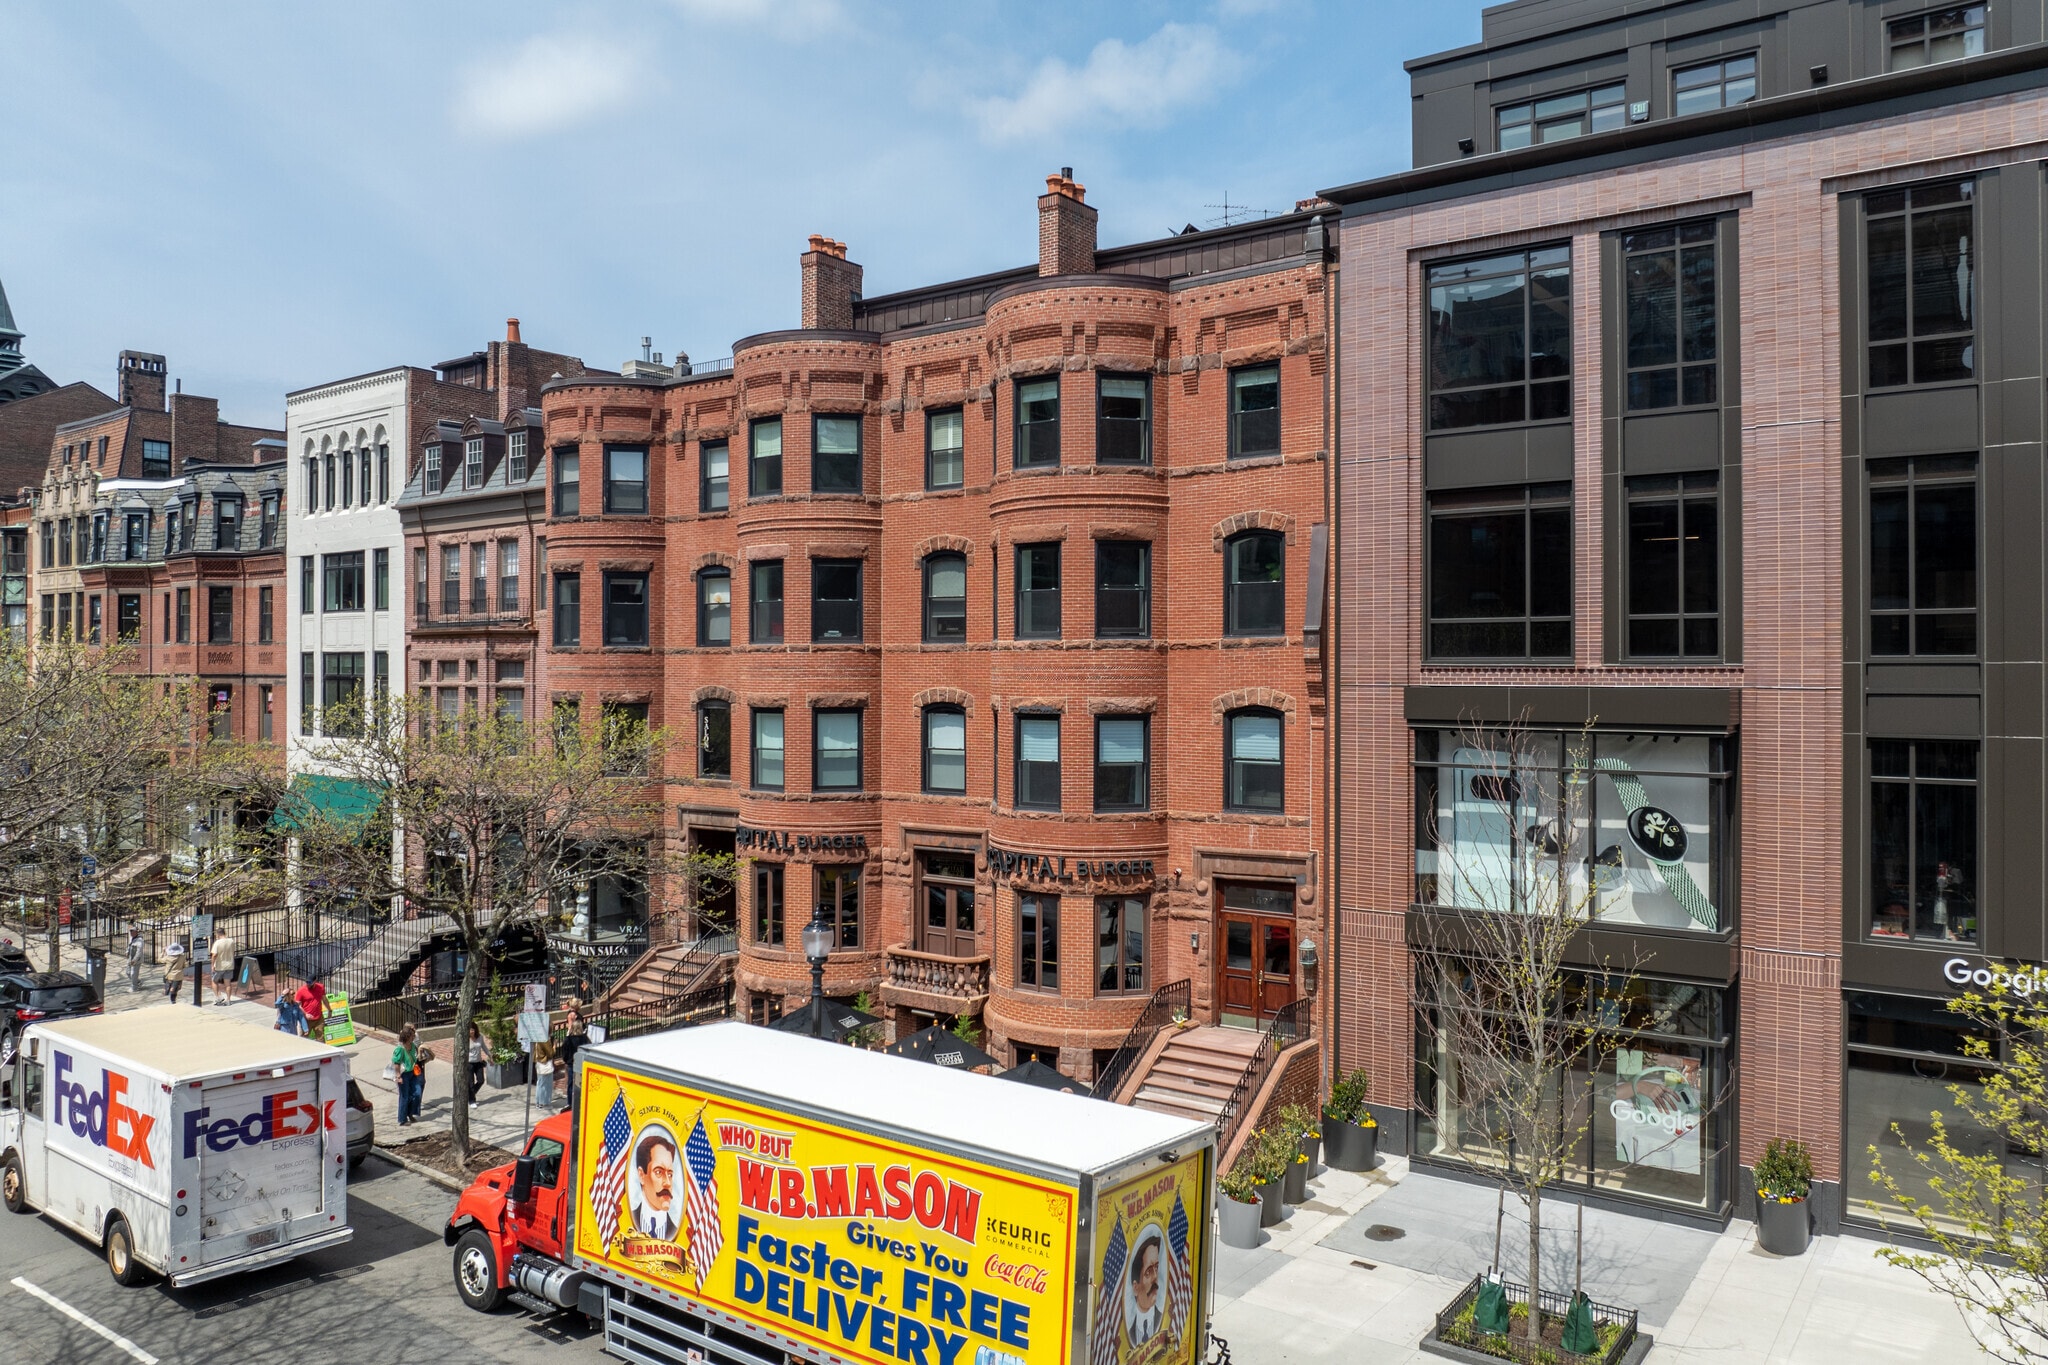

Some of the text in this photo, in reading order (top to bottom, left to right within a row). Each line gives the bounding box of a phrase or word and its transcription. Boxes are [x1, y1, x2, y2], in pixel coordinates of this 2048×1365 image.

[1645, 812, 1666, 826] 12
[798, 834, 866, 849] BURGER
[1663, 833, 1675, 847] 6
[988, 847, 1073, 879] CAPITAL
[1077, 860, 1155, 877] BURGER
[54, 1050, 155, 1170] FedEx
[184, 1090, 338, 1159] FedEx
[639, 1105, 661, 1117] SINCE
[1610, 1100, 1695, 1135] Google
[719, 1125, 792, 1159] WHO BUT
[738, 1156, 982, 1245] W.B.MASON
[1128, 1174, 1175, 1218] W.B.MASON
[847, 1221, 969, 1278] Gives You
[986, 1235, 1051, 1259] COMMERCIAL
[987, 1217, 1051, 1248] KEURIG
[627, 1243, 682, 1259] W.B.MASON
[737, 1213, 1031, 1350] Faster, FREE
[734, 1258, 968, 1365] DELIVERY
